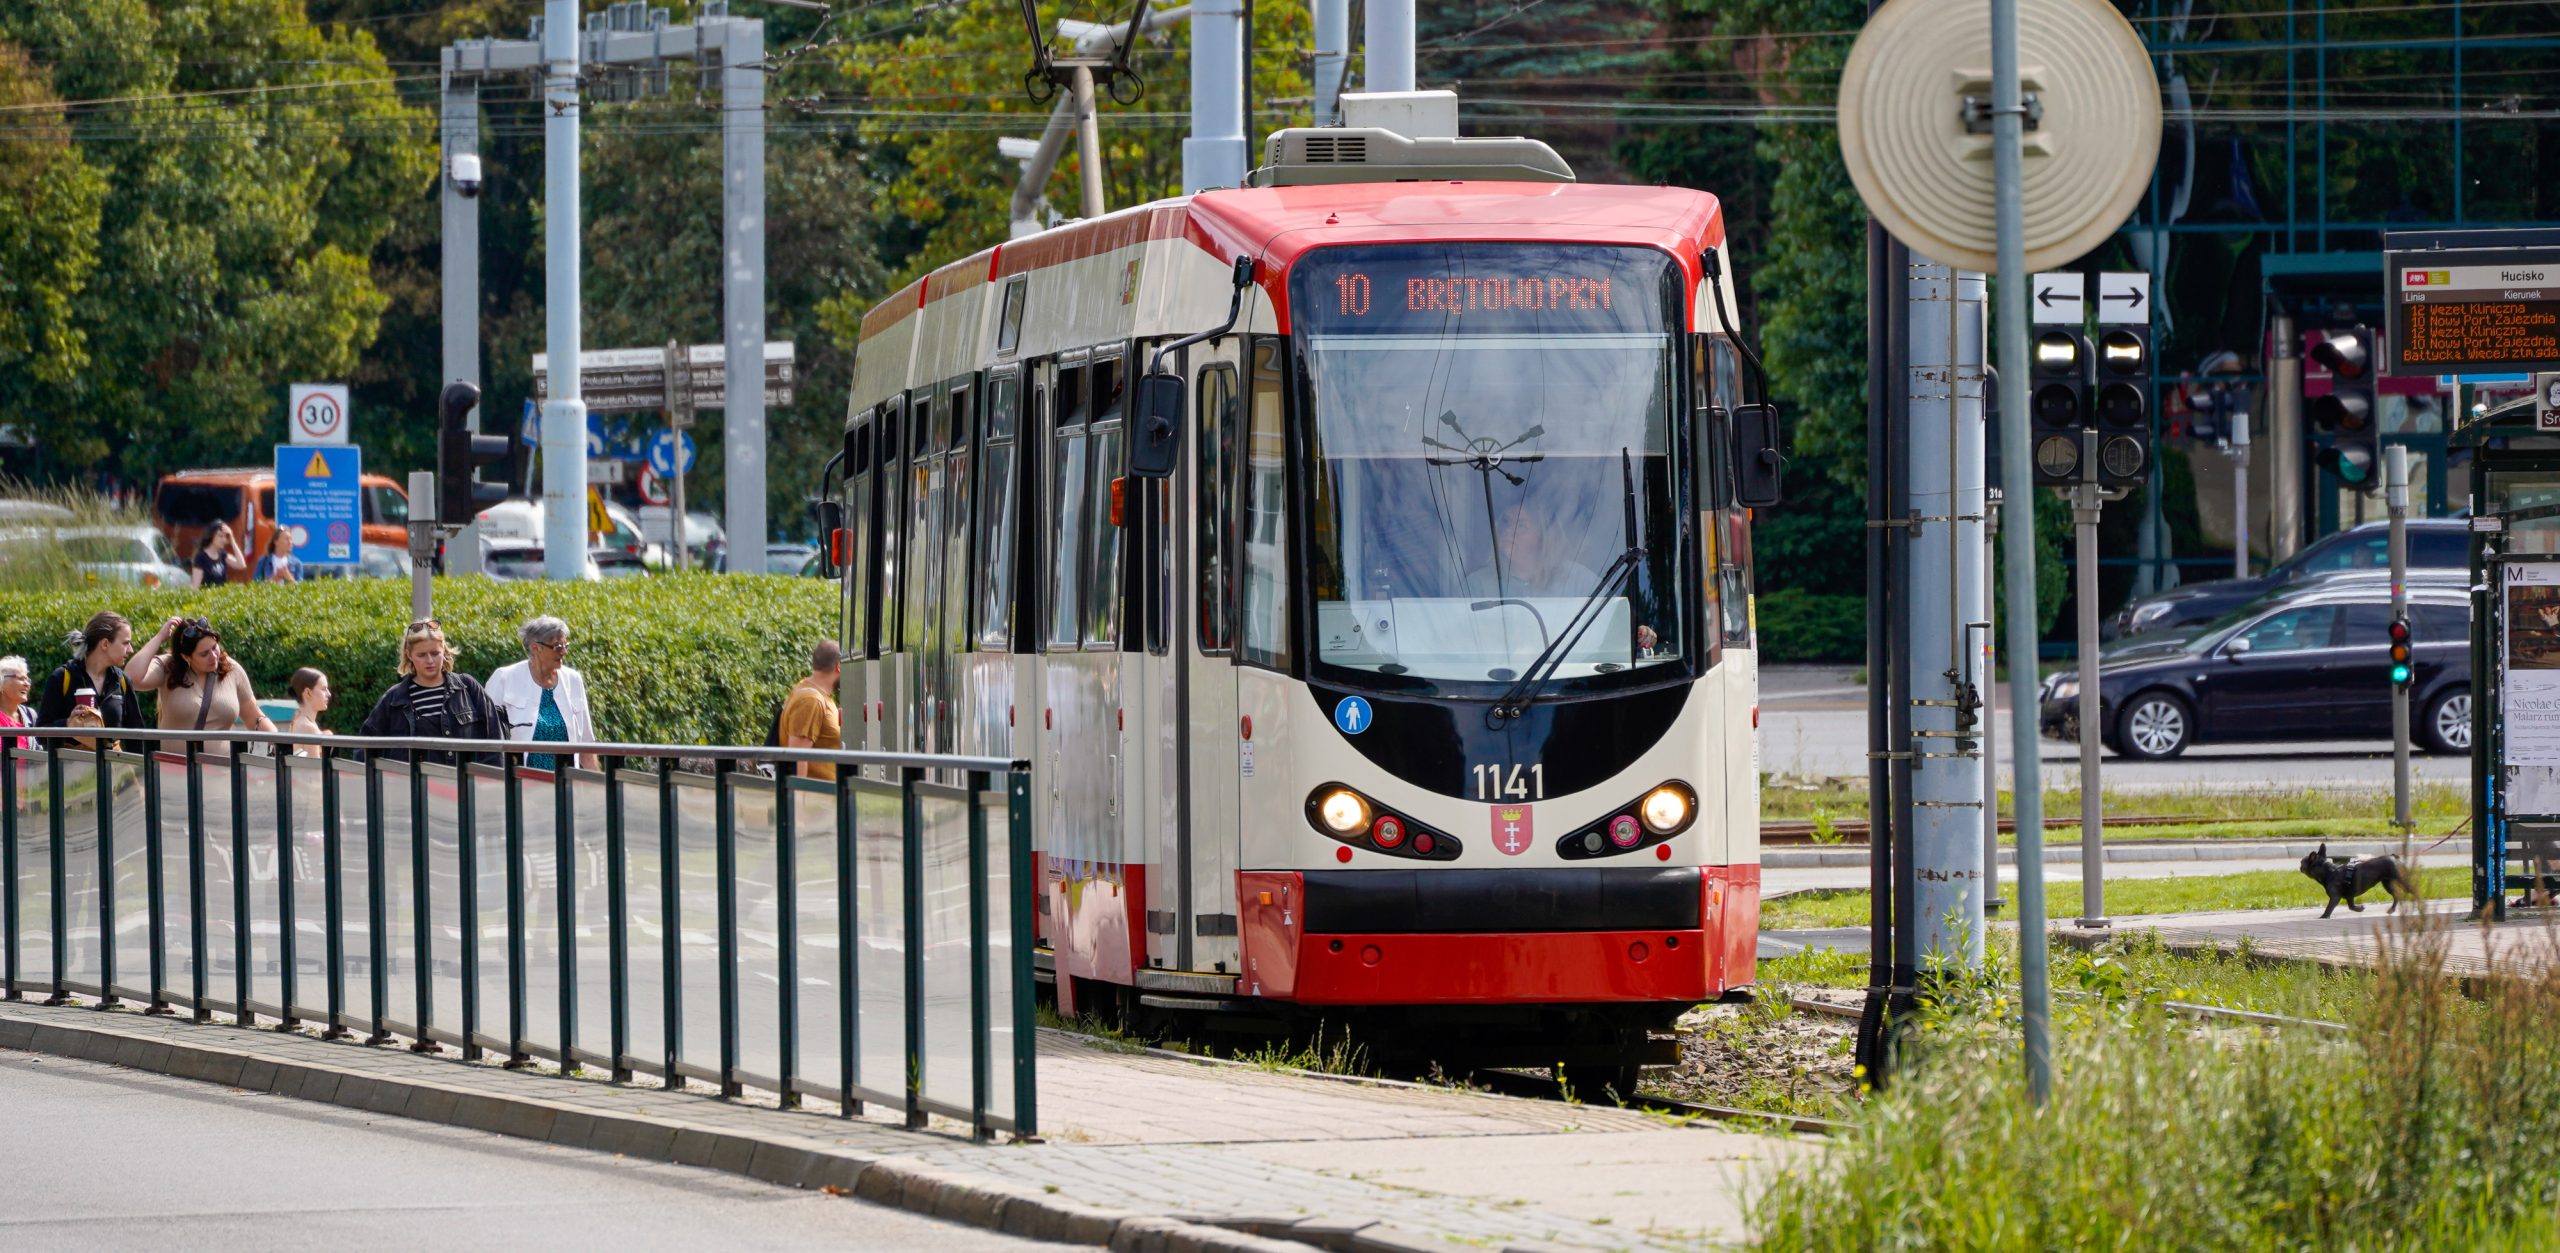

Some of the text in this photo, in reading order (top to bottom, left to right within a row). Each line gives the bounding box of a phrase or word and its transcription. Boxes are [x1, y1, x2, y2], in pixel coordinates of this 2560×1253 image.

[2501, 271, 2545, 282] Hucisko
[1335, 273, 1611, 316] 10 BRĘTOWO PKM
[2405, 292, 2426, 302] Linia
[2504, 290, 2541, 300] Kierunek
[2412, 304, 2425, 316] 12
[2470, 303, 2526, 315] Kliniczna
[2412, 312, 2556, 327] 10 Nowy Port Zajezdnia
[2412, 327, 2425, 338] 12
[2470, 325, 2526, 337] Kliniczna
[2412, 335, 2556, 349] 10 Nowy Port Zajezdnia
[305, 404, 335, 425] 30
[2507, 566, 2523, 582] M
[2514, 698, 2552, 710] Nicolae
[2513, 712, 2543, 721] Malarz
[1473, 763, 1544, 800] 1141
